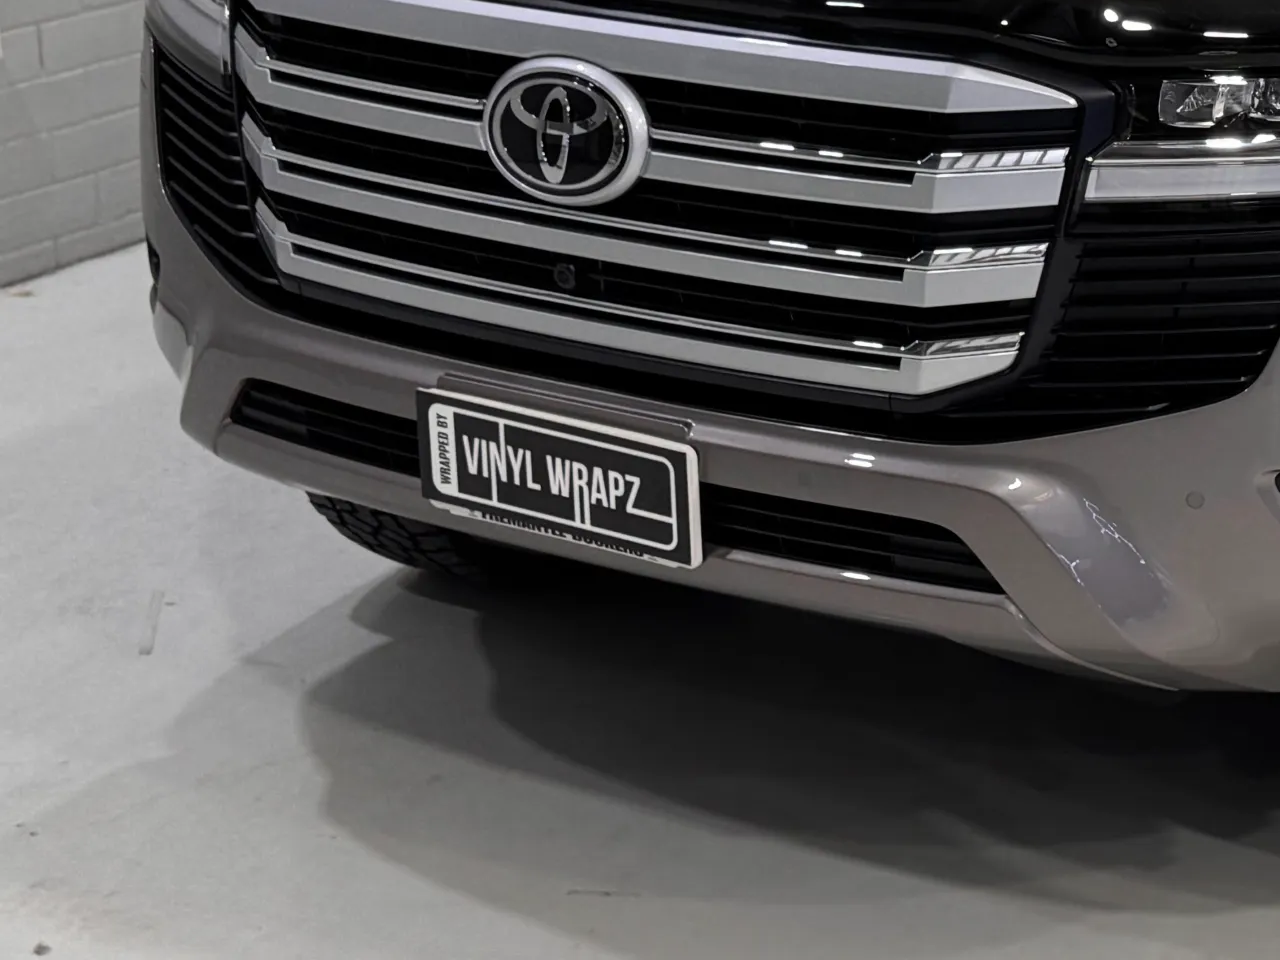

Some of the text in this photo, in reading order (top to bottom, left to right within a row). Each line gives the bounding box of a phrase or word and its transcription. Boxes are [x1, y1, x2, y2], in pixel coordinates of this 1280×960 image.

[436, 412, 452, 485] WRAPPED BY
[462, 433, 642, 522] VINYL WRAPZ
